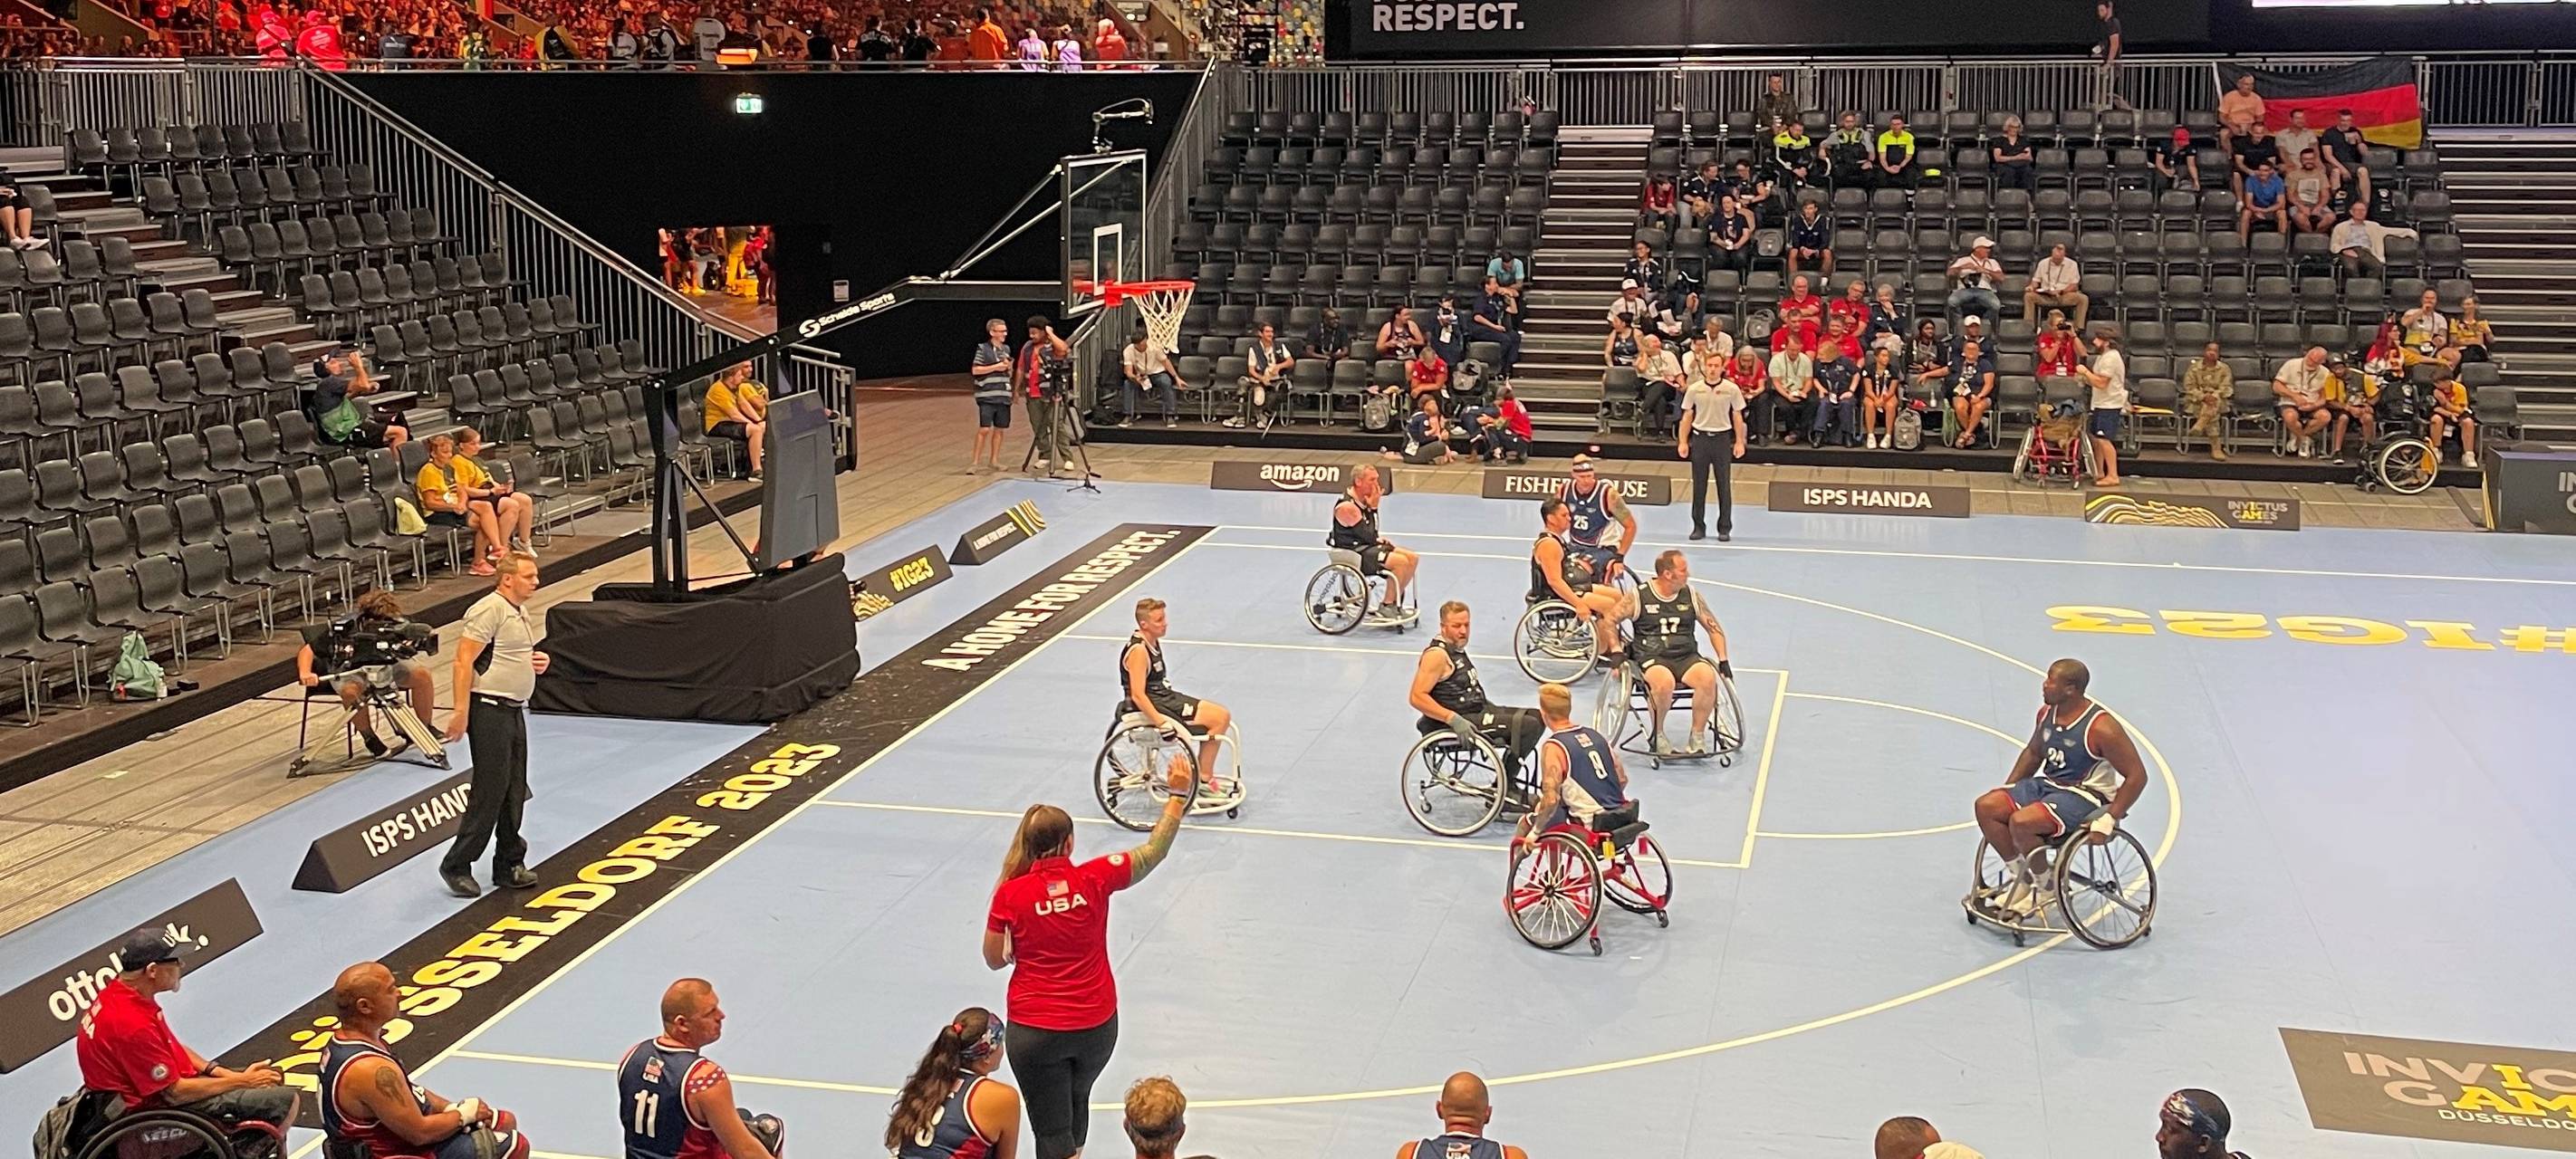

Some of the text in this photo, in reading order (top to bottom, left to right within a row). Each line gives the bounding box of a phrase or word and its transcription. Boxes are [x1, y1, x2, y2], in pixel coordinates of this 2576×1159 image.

[1372, 3, 1524, 32] RESPECT.
[1260, 464, 1340, 483] amazon
[1504, 475, 1572, 493] FISHE
[1803, 488, 1933, 509] ISPS HANDA
[2228, 500, 2288, 512] INVICTUS
[1573, 514, 1589, 530] 25
[2232, 510, 2278, 521] GAMES
[1059, 529, 1182, 589] RESPECT.
[889, 556, 935, 592] #IG23
[1014, 583, 1091, 611] FOR
[940, 610, 1054, 656] HOME
[1659, 617, 1681, 635] 17
[921, 656, 984, 672] A
[697, 742, 841, 811] 2023
[360, 782, 472, 857] ISPS HAND
[1034, 893, 1088, 916] USA
[634, 1088, 659, 1138] 11
